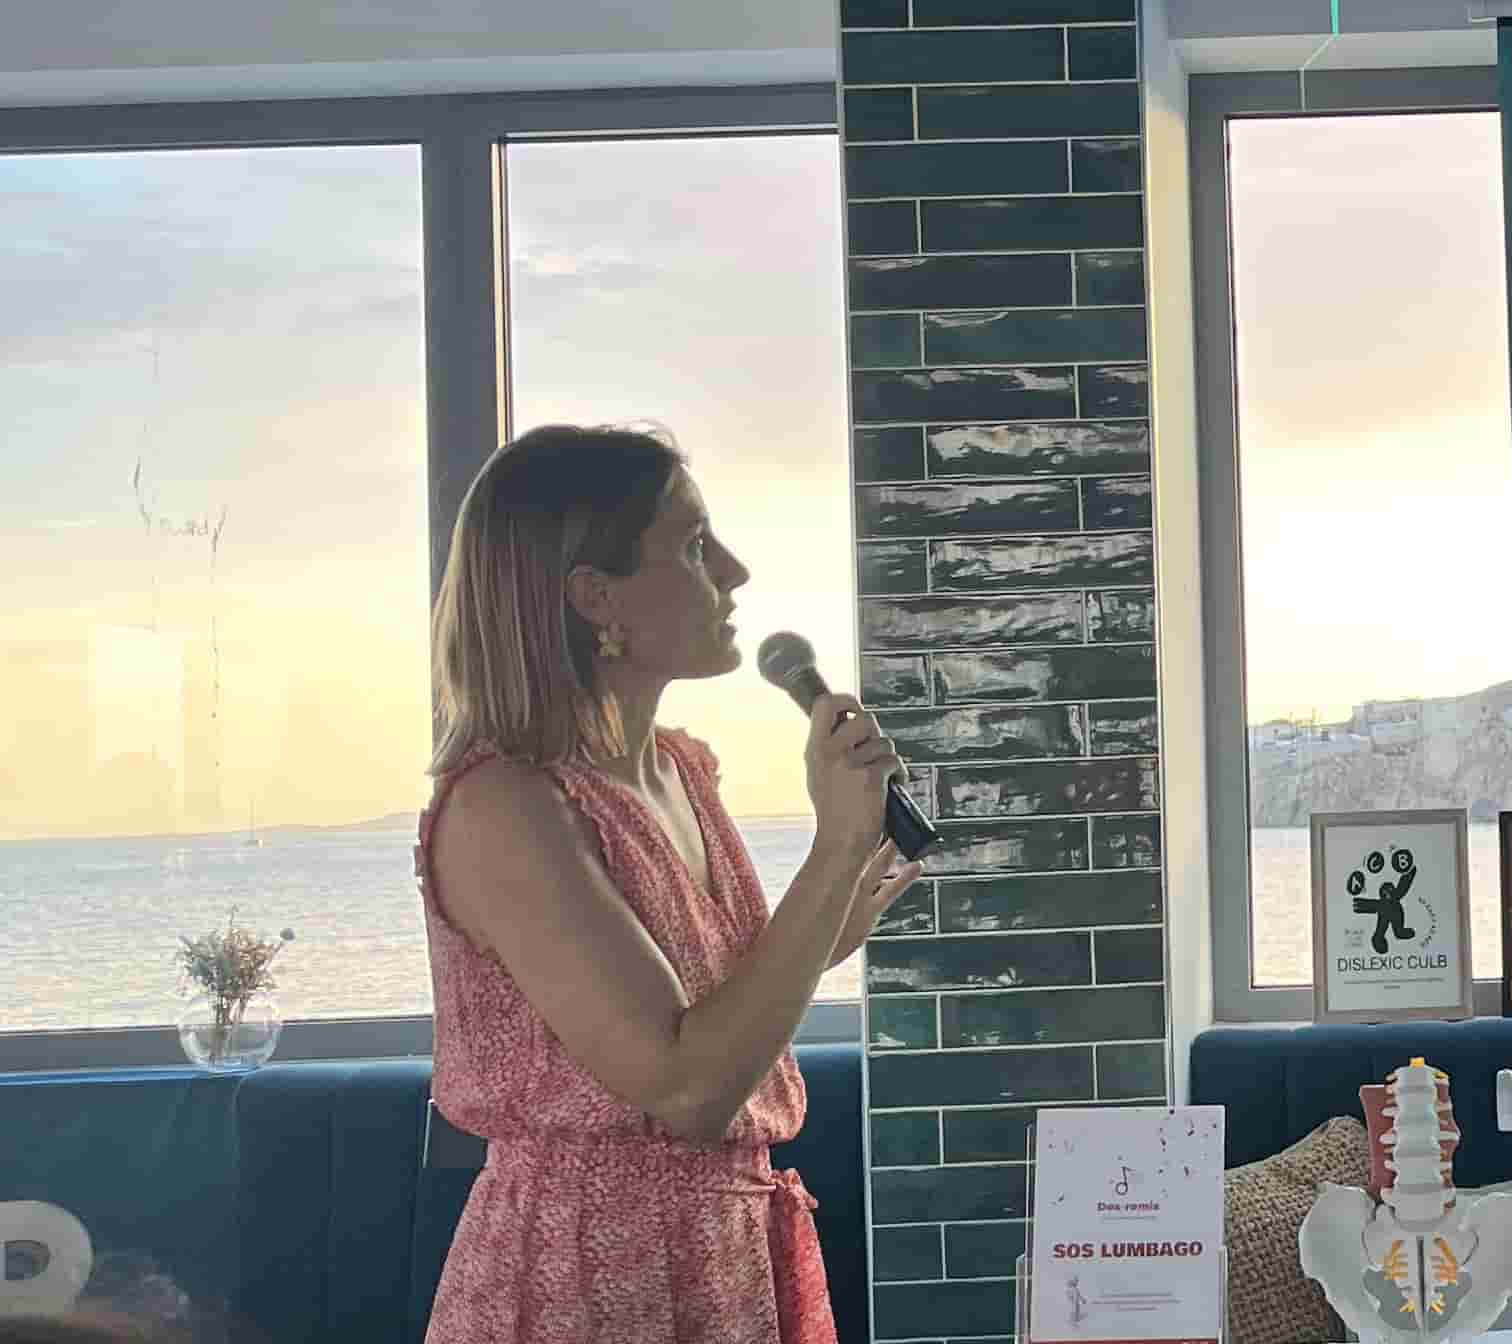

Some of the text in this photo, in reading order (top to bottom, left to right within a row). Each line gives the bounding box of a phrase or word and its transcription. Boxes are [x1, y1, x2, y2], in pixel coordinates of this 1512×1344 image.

[1336, 955, 1448, 972] DISLEXIC CULB
[1053, 1241, 1203, 1258] SOS LUMBAGO
